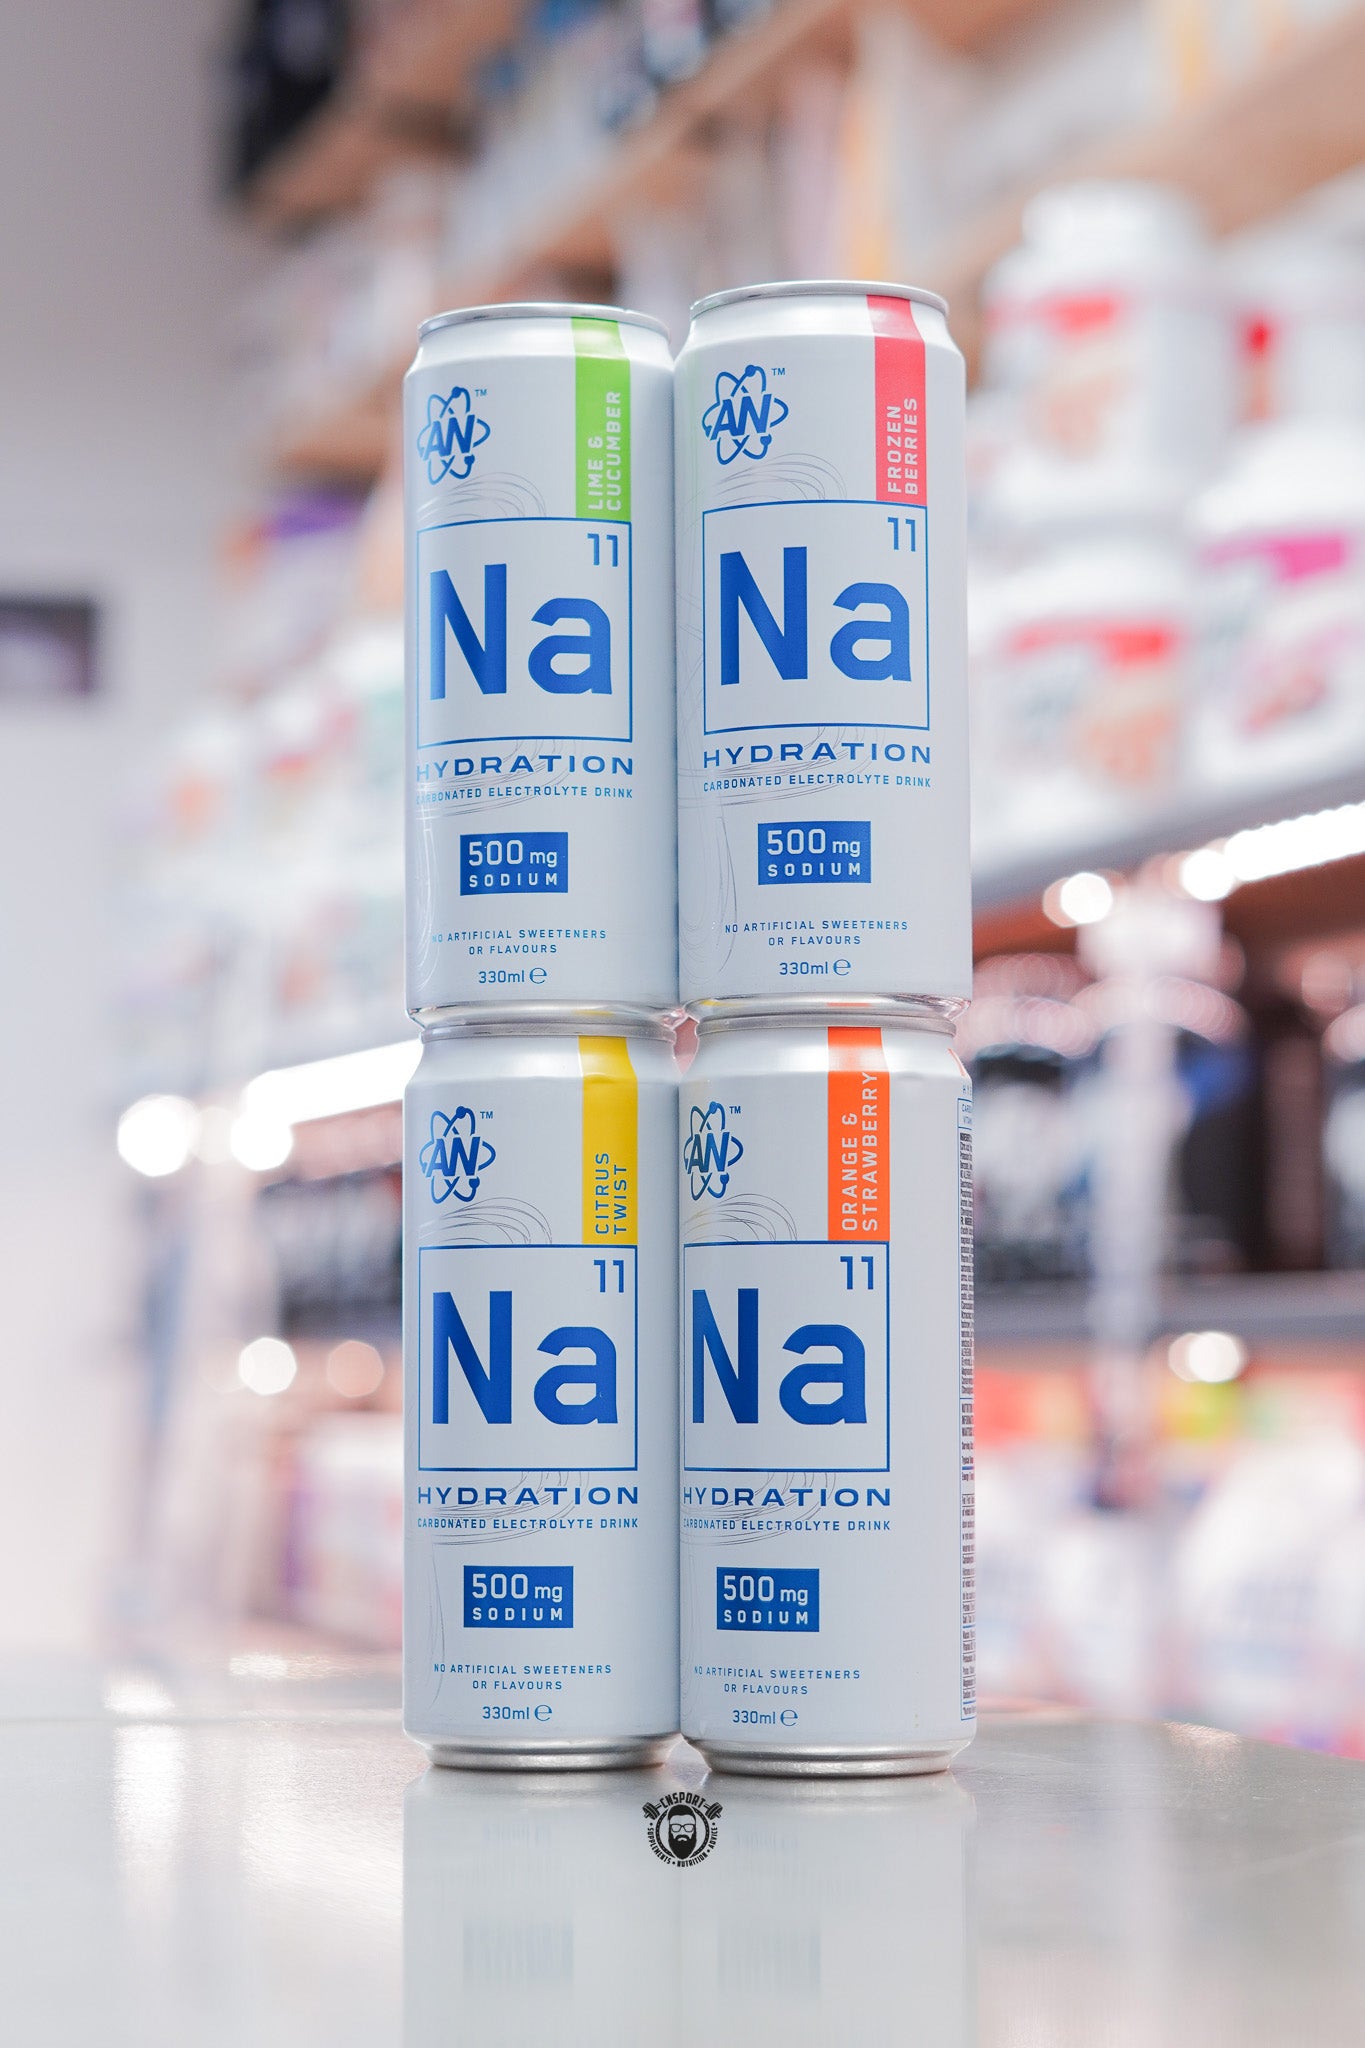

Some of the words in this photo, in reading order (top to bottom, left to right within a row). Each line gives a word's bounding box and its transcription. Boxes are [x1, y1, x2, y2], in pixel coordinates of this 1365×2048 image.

[710, 394, 772, 441] AN
[423, 414, 475, 460] AN
[588, 436, 603, 448] &
[888, 406, 901, 493] FROZEN
[904, 398, 918, 495] BERRIES
[607, 392, 621, 511] CUCUMBER
[588, 459, 603, 510] LIME
[888, 517, 916, 552] 11
[587, 533, 618, 567] 11
[720, 546, 911, 685] Na
[430, 564, 612, 700] Na
[704, 742, 931, 768] HYDRATION
[417, 755, 633, 782] HYDRATION
[488, 786, 588, 797] ELECTROLYTE
[595, 787, 633, 799] DRINK
[704, 776, 782, 792] CARBONATED
[789, 774, 889, 785] ELECTROLYTE
[896, 776, 931, 788] DRINK
[469, 840, 523, 866] 500
[529, 851, 557, 867] mg
[767, 828, 826, 855] 500
[832, 840, 861, 858] mg
[469, 873, 558, 887] SODIUM
[768, 863, 860, 877] SODIUM
[447, 930, 512, 941] ARTIFICIAL
[519, 929, 606, 939] SWEETENERS
[725, 924, 738, 933] NO
[744, 921, 815, 932] ARTIFICIAL
[822, 920, 908, 930] SWEETENERS
[469, 946, 483, 955] OR
[490, 944, 557, 954] FLAVOURS
[768, 937, 784, 946] OR
[791, 936, 861, 945] FLAVOURS
[478, 970, 525, 984] 330ml
[779, 961, 828, 975] 330ml
[842, 1112, 858, 1126] &
[425, 1136, 481, 1178] AN
[687, 1132, 730, 1175] AN
[862, 1071, 878, 1232] STRAWBERRY
[595, 1153, 609, 1235] CITRUS
[842, 1137, 858, 1231] ORANGE
[614, 1164, 627, 1235] TWIST
[594, 1260, 624, 1293] 11
[840, 1256, 873, 1290] 11
[433, 1290, 618, 1425] Na
[692, 1287, 868, 1425] Na
[418, 1487, 638, 1505] HYDRATION
[684, 1487, 891, 1507] HYDRATION
[418, 1518, 486, 1529] CARBONATED
[494, 1519, 593, 1529] ELECTROLYTE
[600, 1518, 638, 1528] DRINK
[741, 1520, 840, 1531] ELECTROLYTE
[848, 1520, 891, 1531] DRINK
[472, 1573, 528, 1599] 500
[534, 1586, 562, 1603] mg
[724, 1575, 775, 1602] 500
[780, 1589, 809, 1606] mg
[472, 1607, 563, 1621] SODIUM
[724, 1609, 809, 1625] SODIUM
[434, 1663, 446, 1673] NO
[450, 1664, 517, 1675] ARTIFICIAL
[523, 1665, 612, 1675] SWEETENERS
[706, 1667, 764, 1678] ARTIFICIAL
[770, 1669, 860, 1680] SWEETENERS
[472, 1680, 487, 1689] OR
[494, 1681, 563, 1690] FLAVOURS
[724, 1684, 737, 1693] OR
[742, 1684, 808, 1695] FLAVOURS
[482, 1706, 530, 1720] 330ml
[732, 1710, 776, 1724] 330ml
